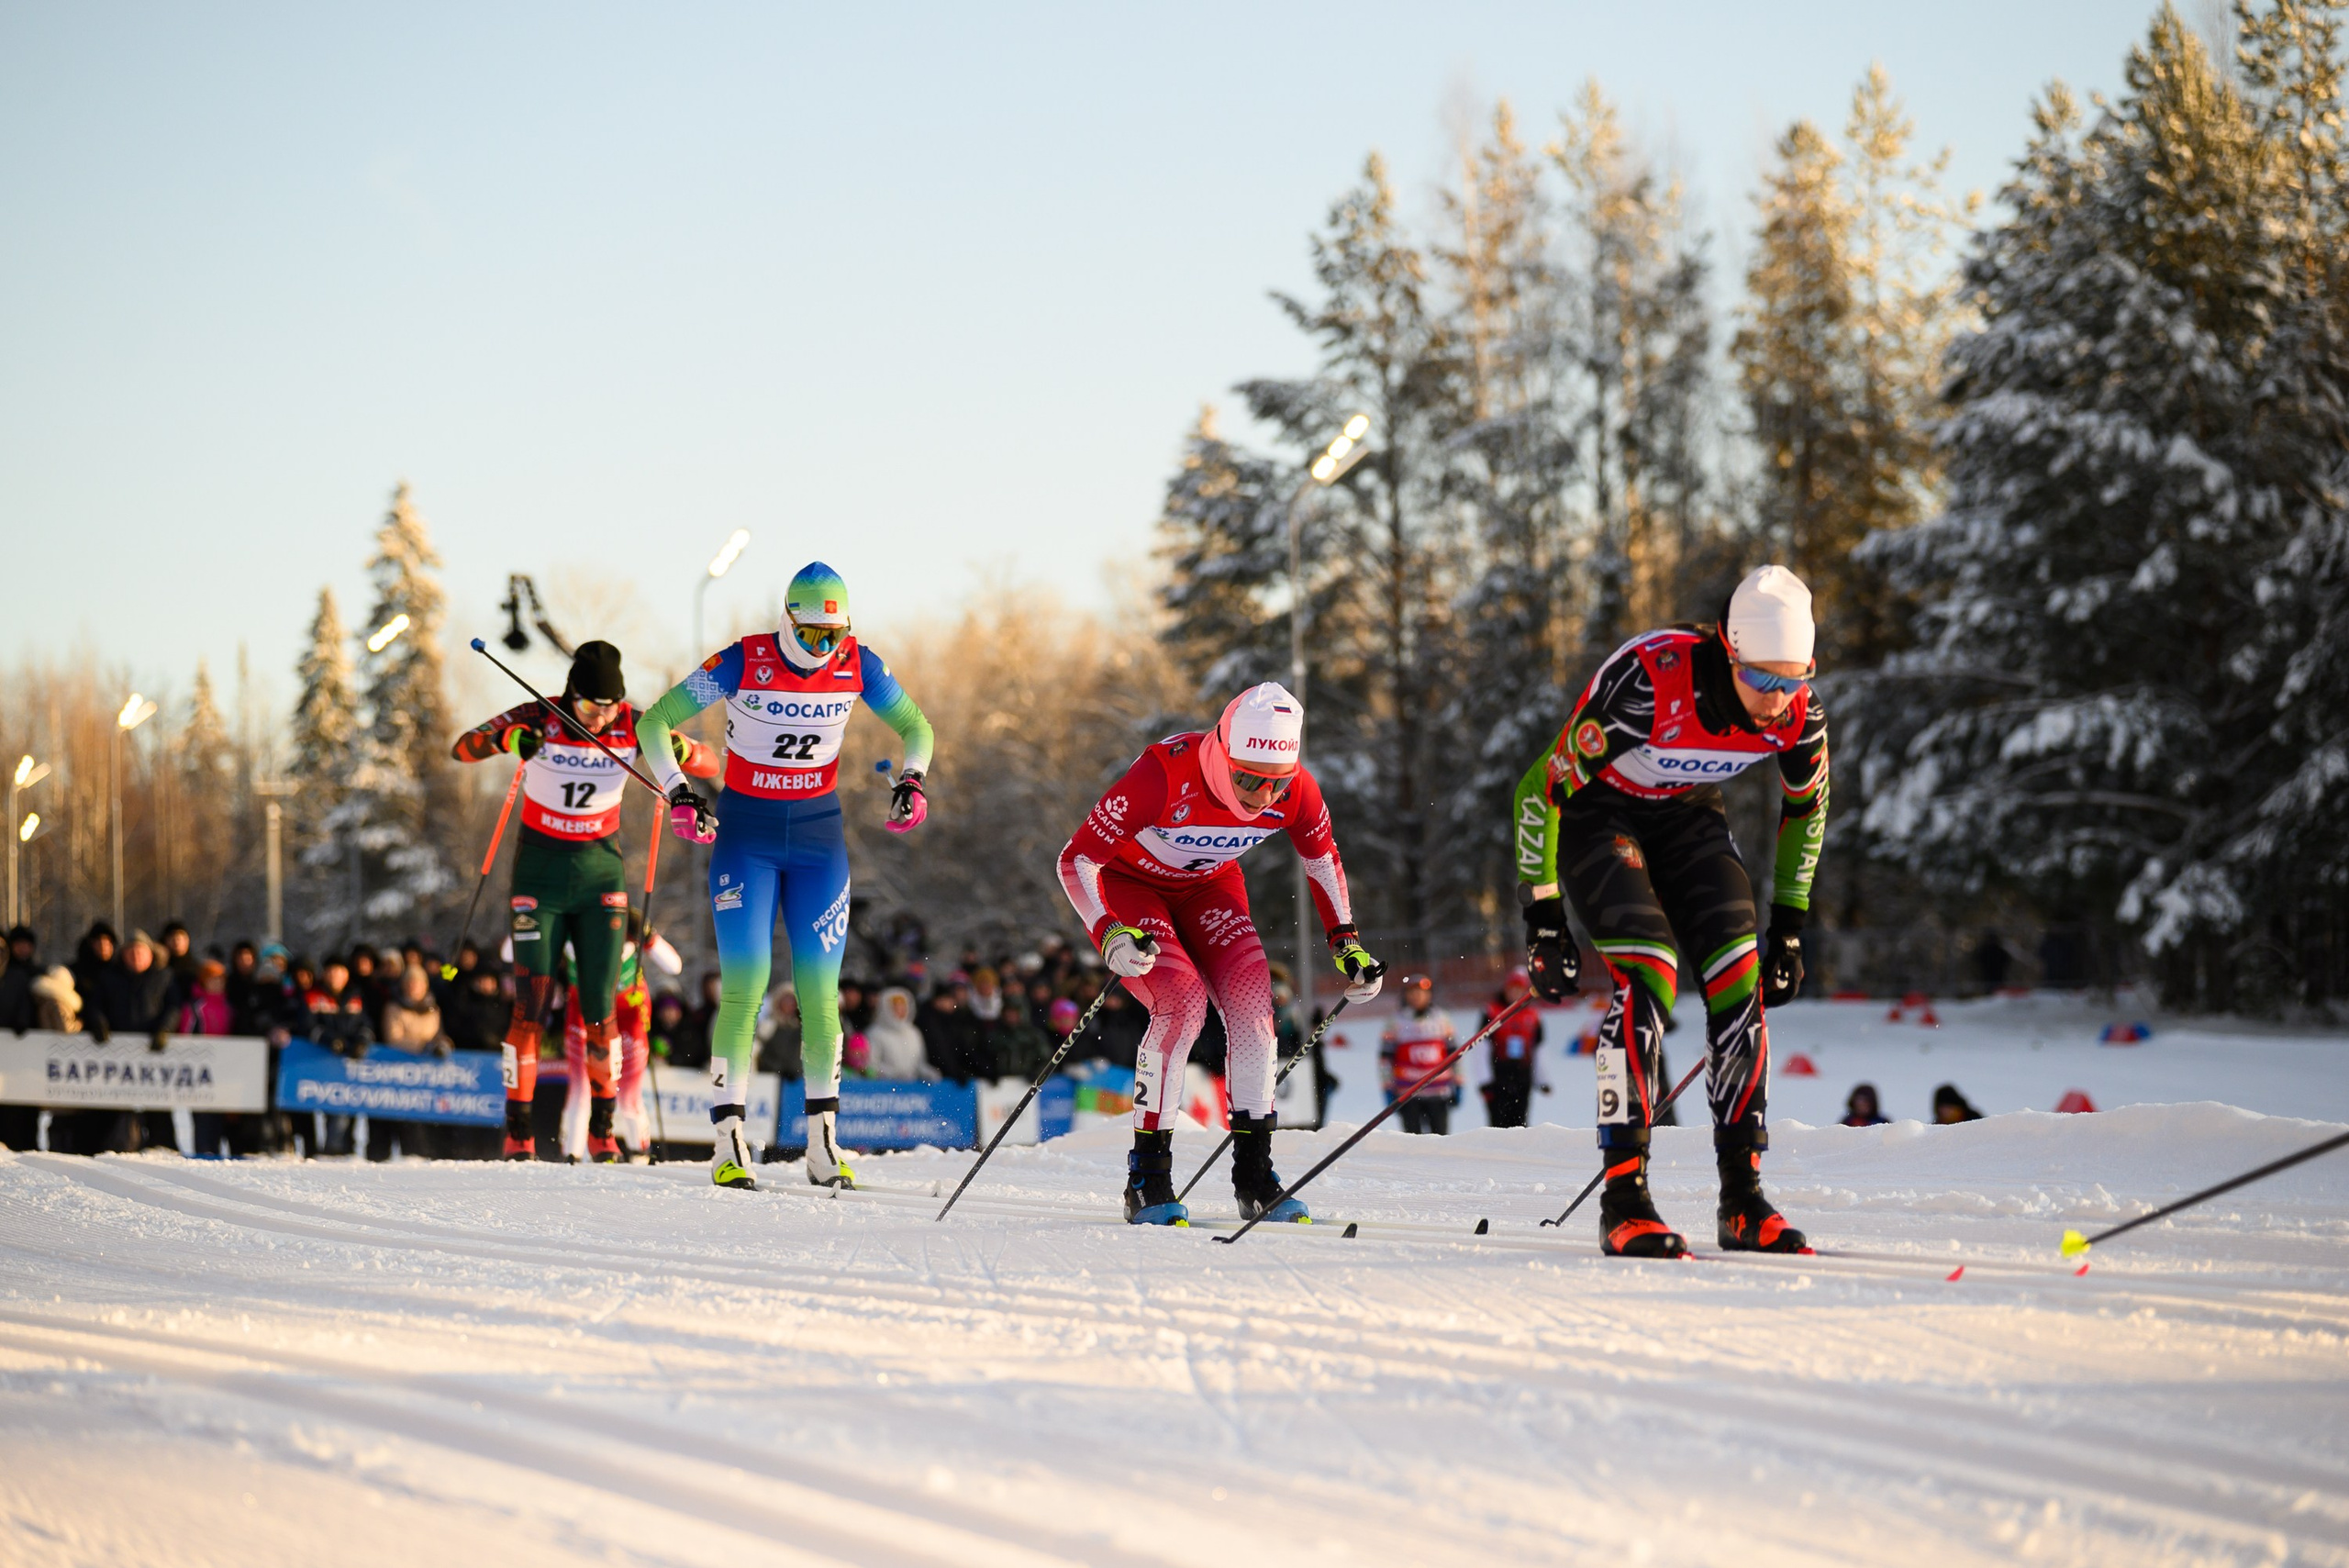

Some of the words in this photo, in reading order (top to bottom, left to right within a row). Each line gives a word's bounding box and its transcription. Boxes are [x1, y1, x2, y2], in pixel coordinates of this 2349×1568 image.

[773, 733, 821, 760] 22
[1246, 738, 1298, 751] ЛУКОЙЛ
[552, 753, 629, 769] ФОСАГР
[1657, 757, 1752, 773] ФОСАГ
[751, 771, 823, 790] ИЖЕВСК
[561, 782, 596, 808] 12
[541, 813, 603, 834] ИЖЕВСК
[1087, 815, 1115, 845] IVIUM
[1094, 801, 1124, 836] ОСАГРО
[1174, 834, 1264, 849] ФОСАГР
[812, 874, 851, 933] РЕСПУБЛ
[1137, 917, 1175, 935] ЛУКО
[47, 1061, 214, 1087] БАРРАКУДА
[1134, 1081, 1148, 1106] 2
[1598, 1088, 1620, 1118] 9
